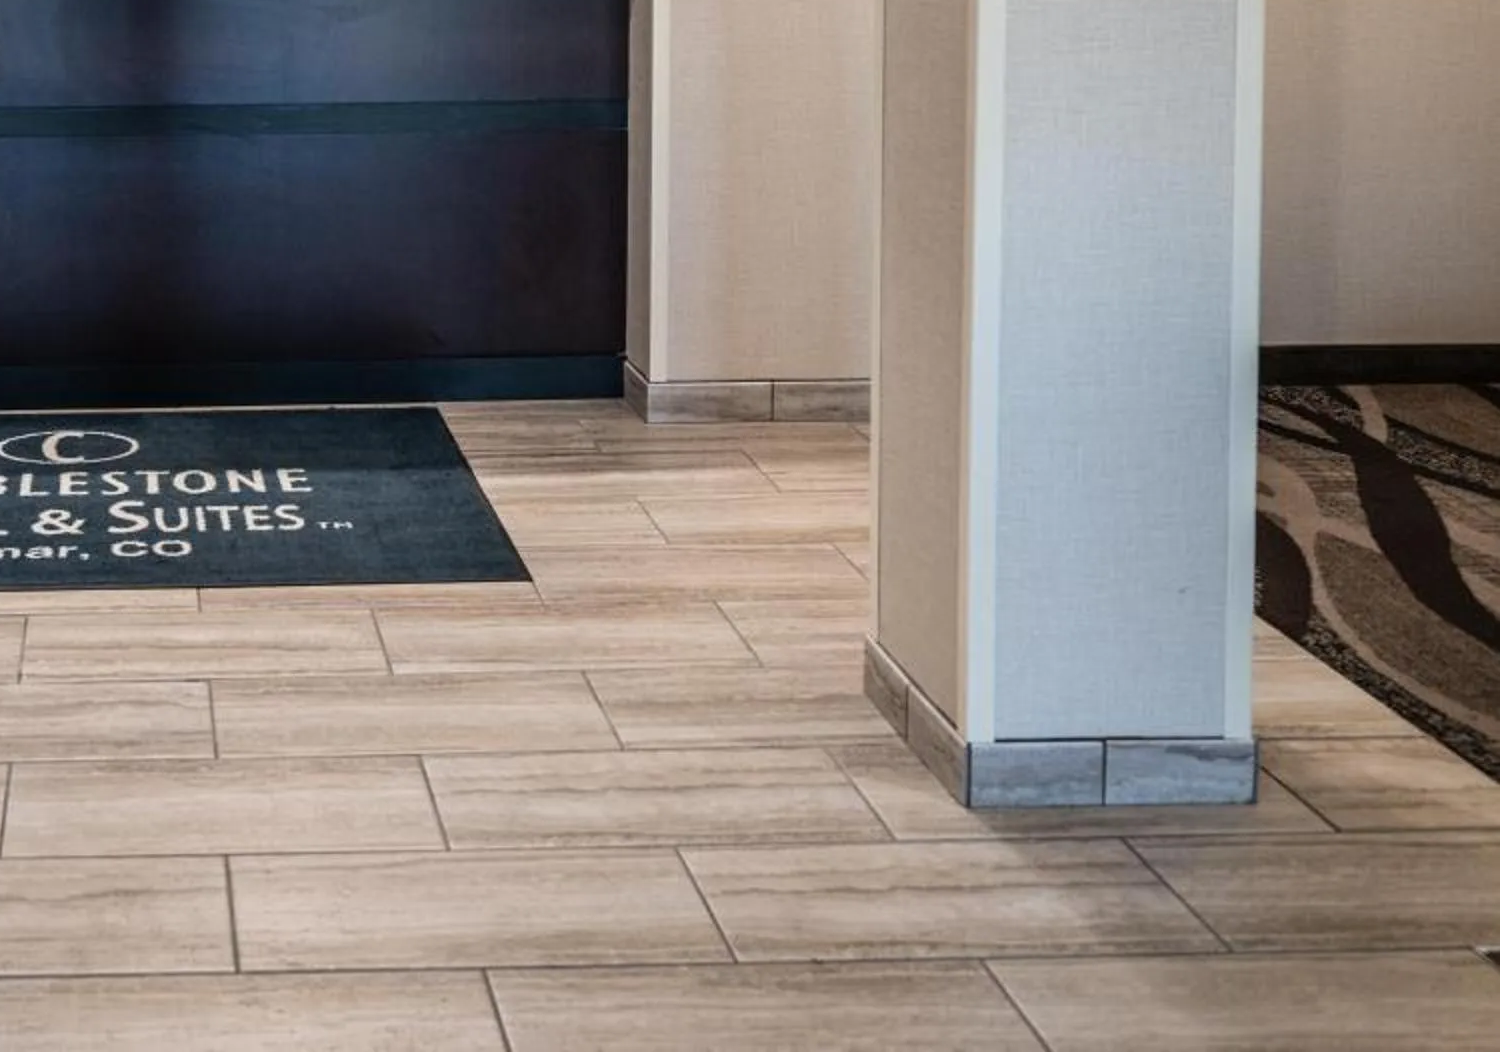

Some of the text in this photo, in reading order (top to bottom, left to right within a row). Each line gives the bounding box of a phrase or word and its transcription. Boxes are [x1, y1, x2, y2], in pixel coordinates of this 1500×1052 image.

[29, 508, 85, 536] &
[105, 499, 306, 536] SUITES
[109, 540, 194, 558] CO
